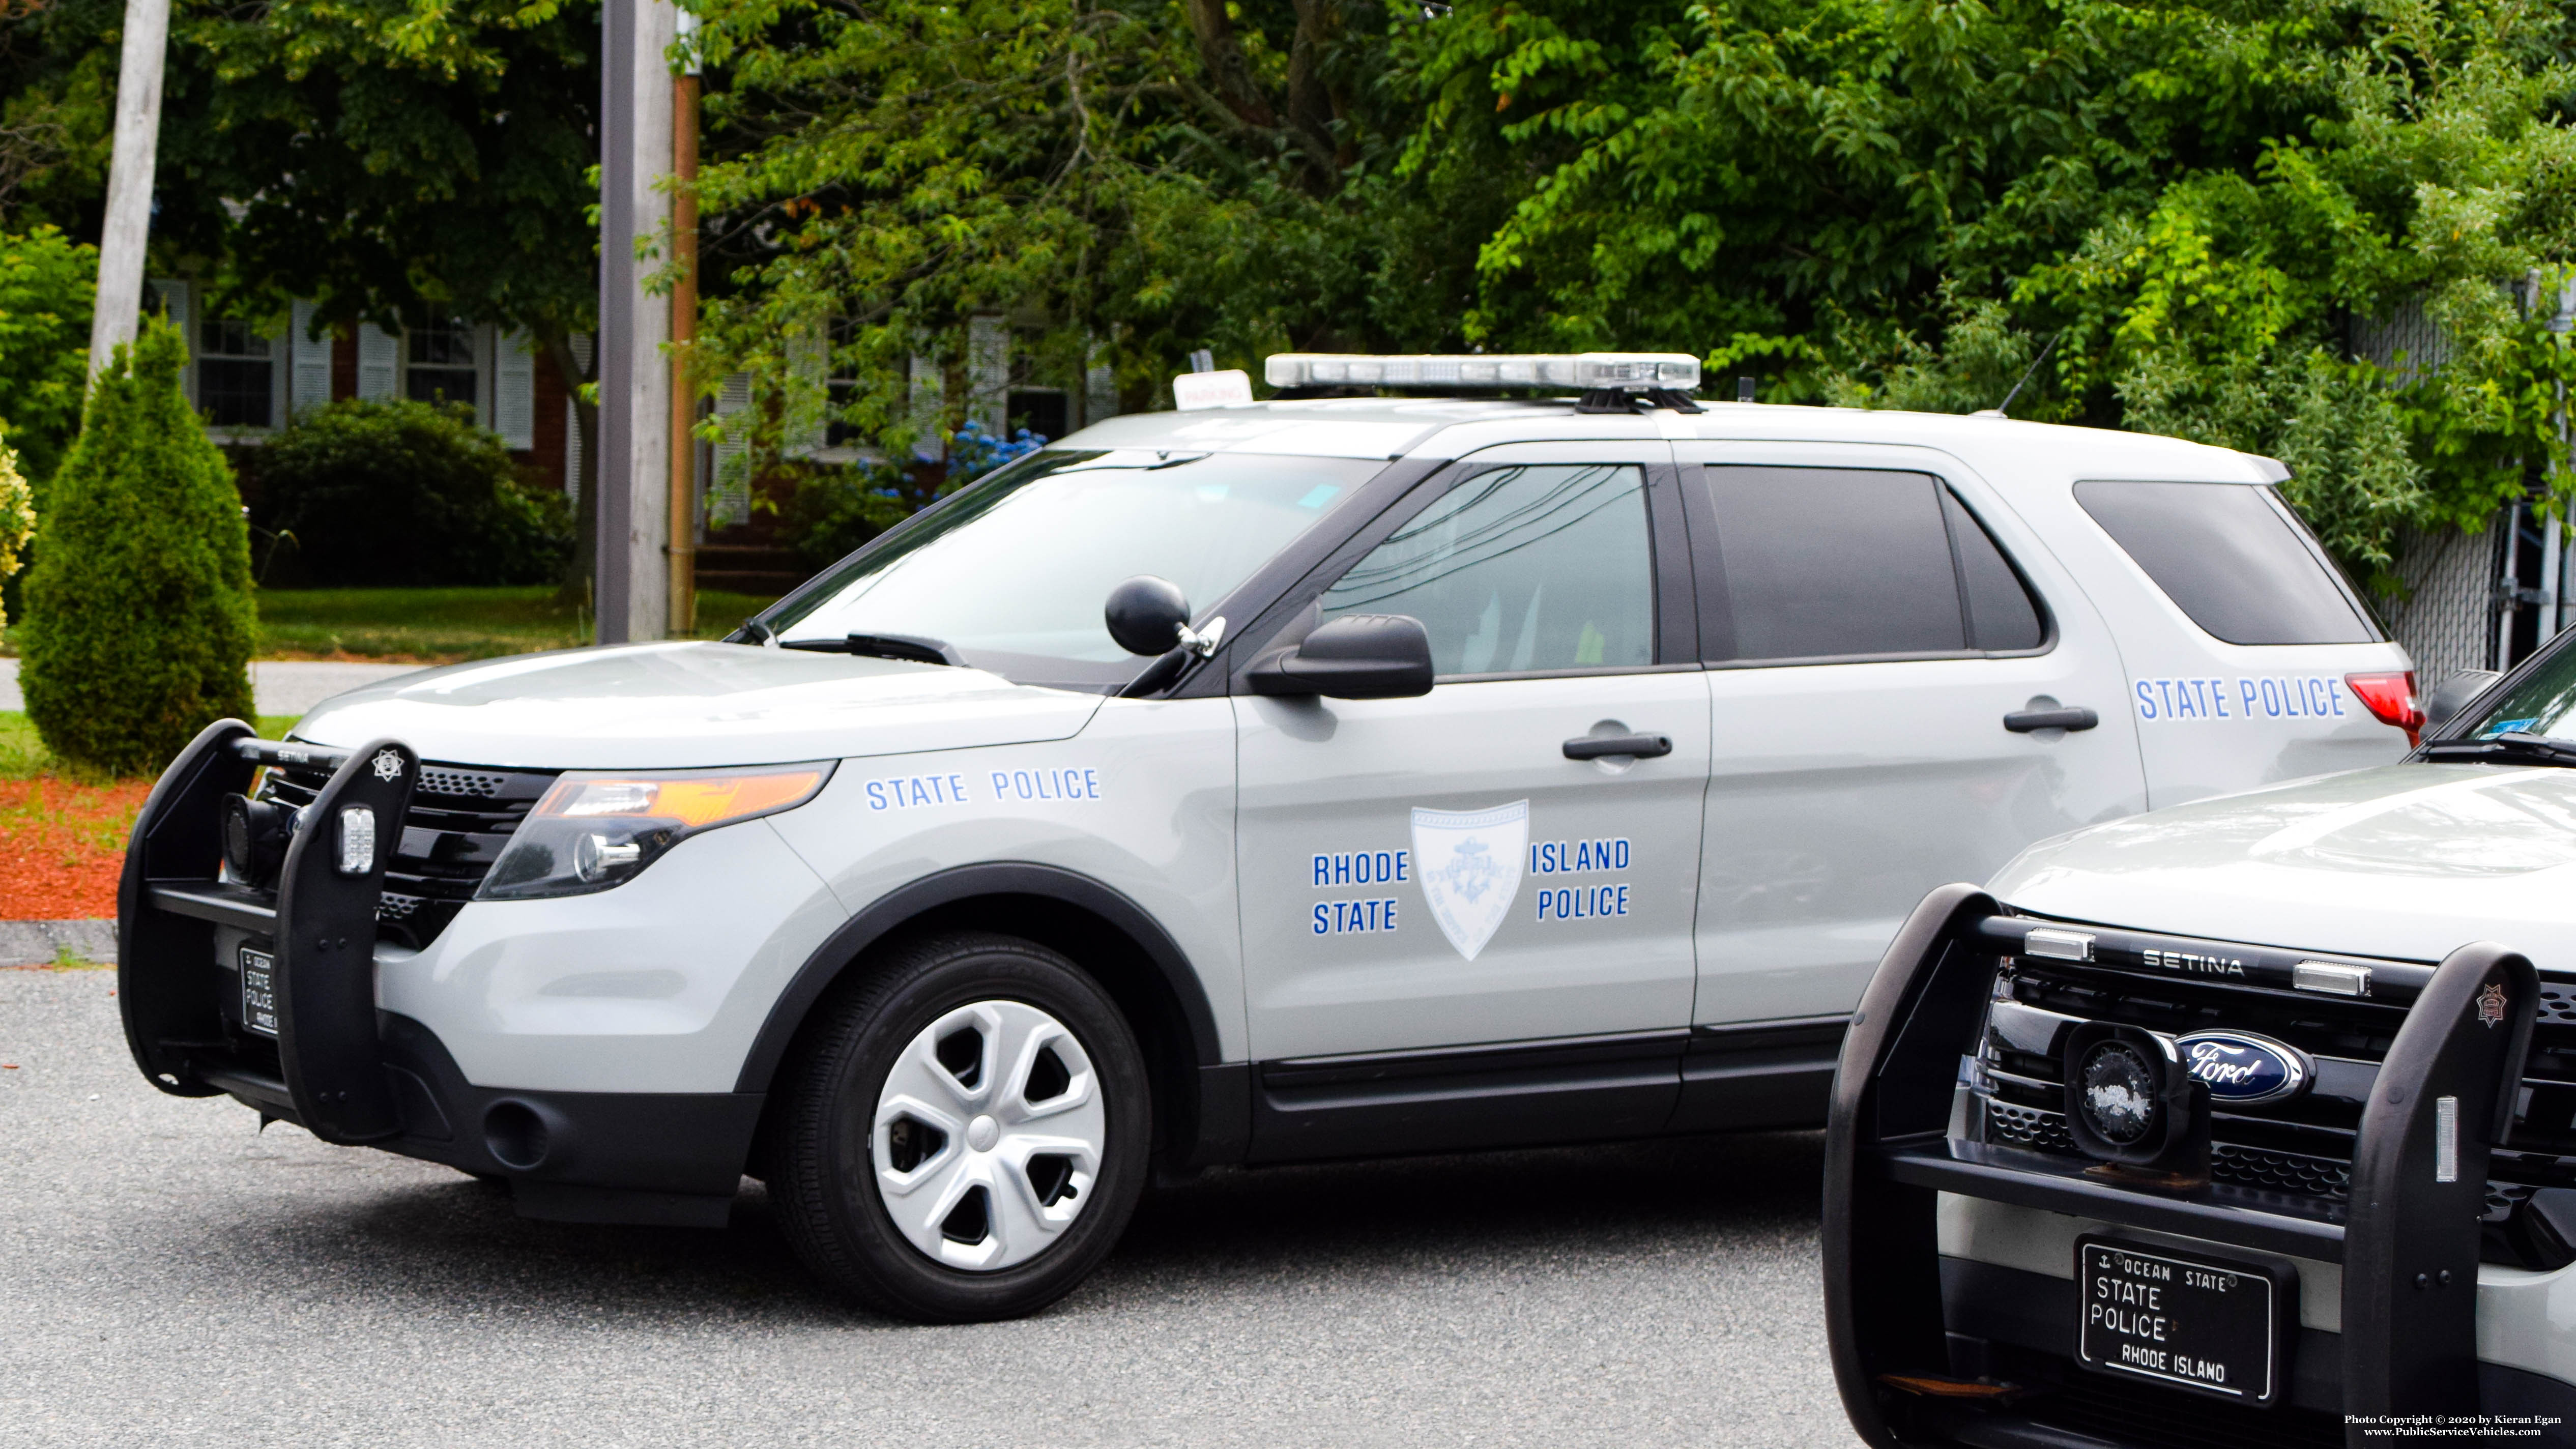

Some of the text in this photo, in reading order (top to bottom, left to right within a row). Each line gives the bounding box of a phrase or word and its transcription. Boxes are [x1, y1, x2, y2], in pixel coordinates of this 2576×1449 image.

[2136, 678, 2345, 719] STATE POLICE
[866, 769, 1099, 810] STATE POLICE
[1314, 851, 1409, 886] RHODE
[1531, 839, 1629, 874] ISLAND
[1314, 900, 1397, 935] STATE
[1537, 885, 1628, 920] POLICE
[247, 970, 271, 990] STATE
[2143, 949, 2245, 977] SETINA
[246, 989, 274, 1010] POLICE
[2187, 1042, 2262, 1084] Ford
[2124, 1259, 2226, 1292] OCEAN STATE
[2097, 1277, 2161, 1311] STATE
[2091, 1303, 2166, 1341] POLICE
[2122, 1344, 2225, 1383] RHODE ISLAND
